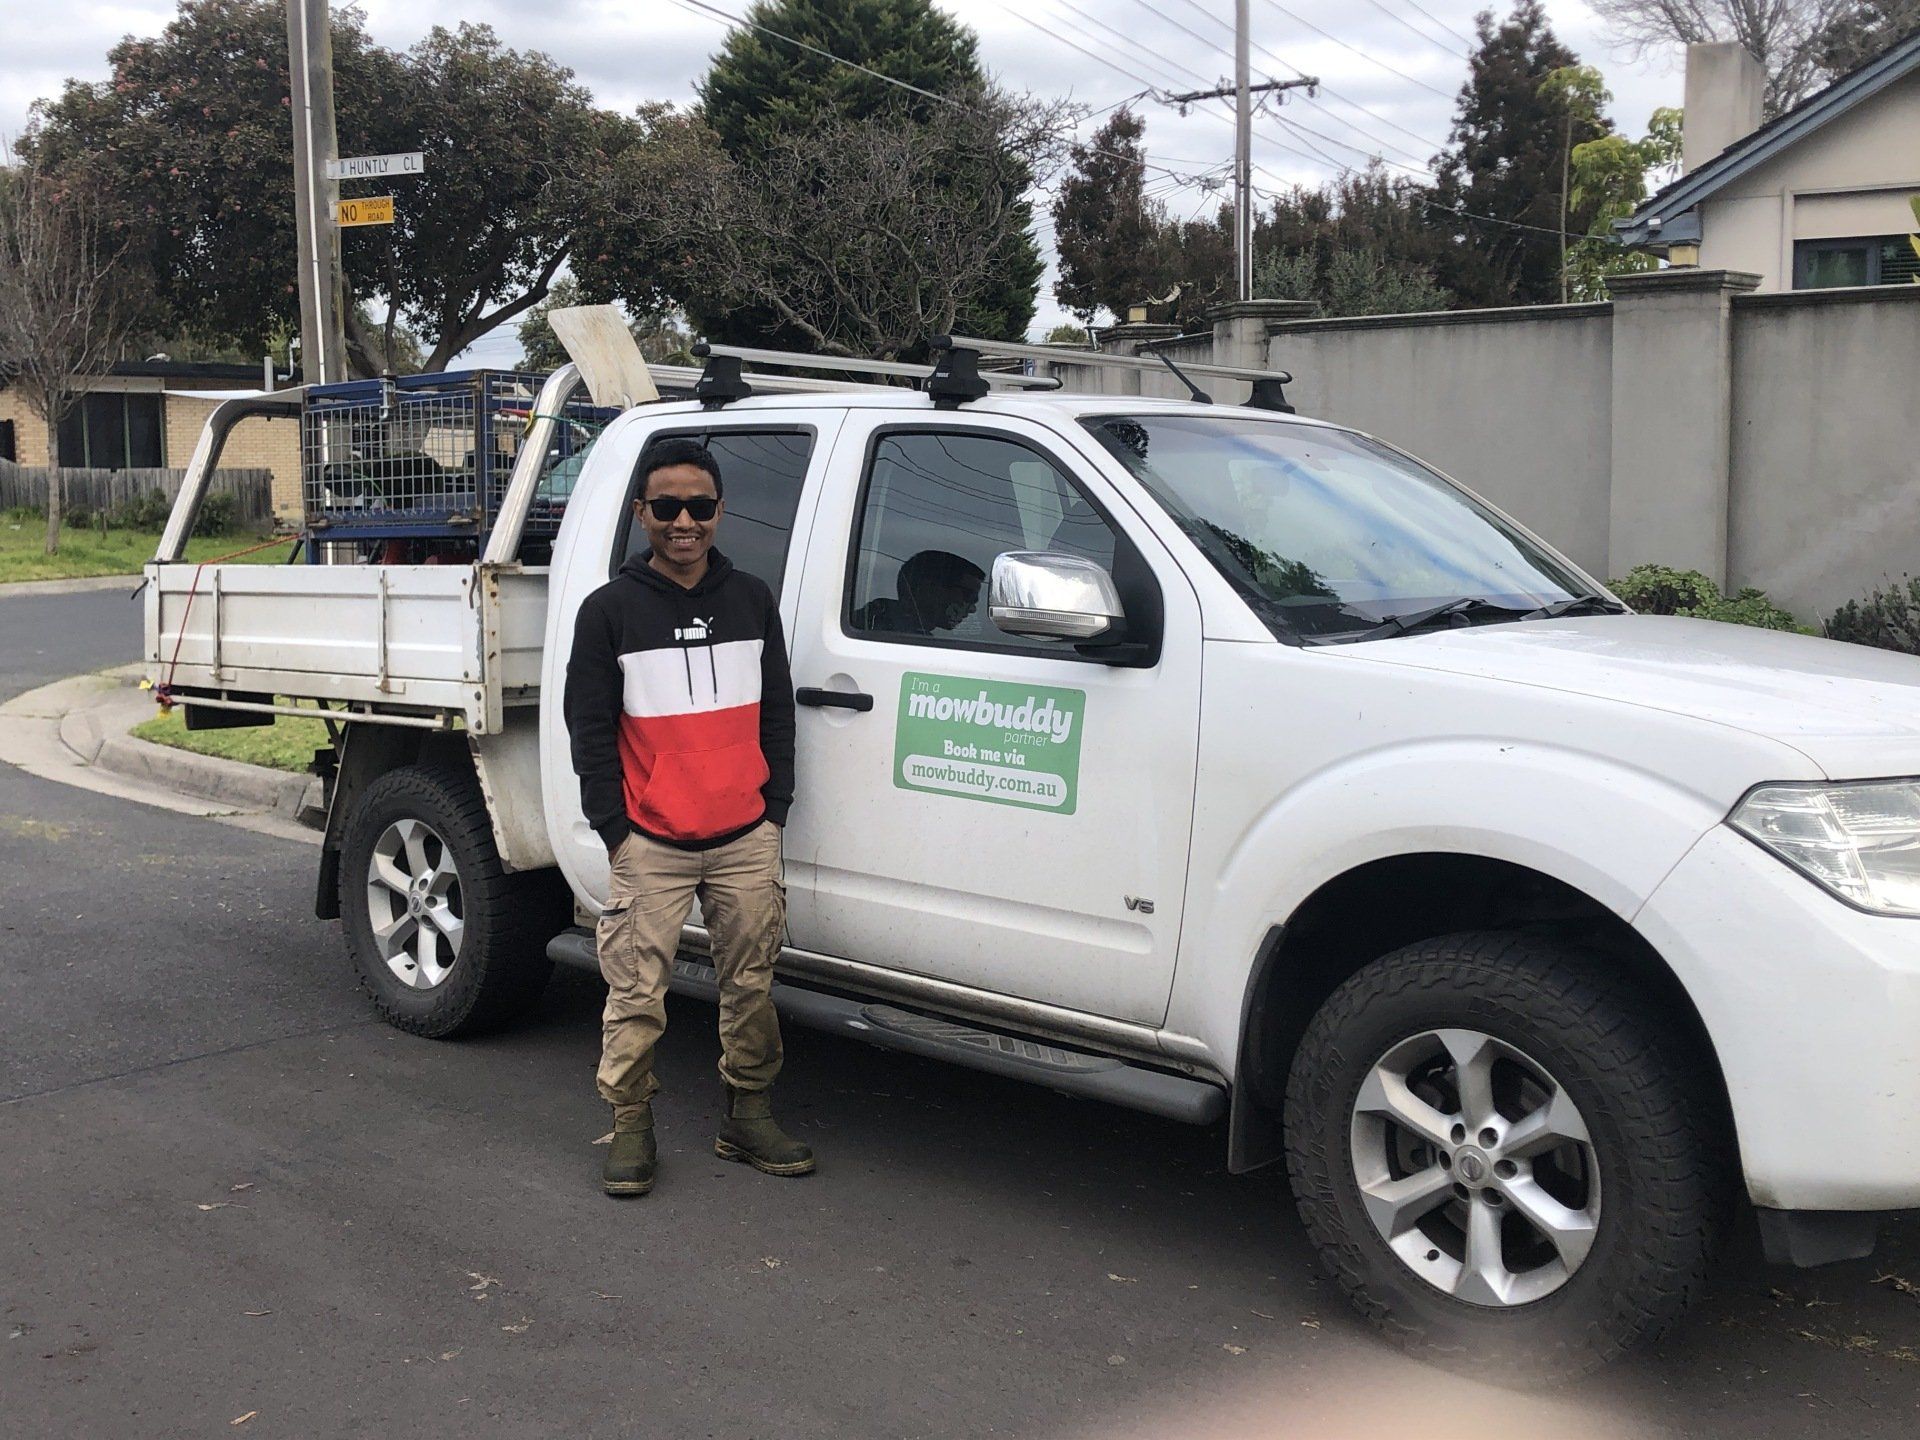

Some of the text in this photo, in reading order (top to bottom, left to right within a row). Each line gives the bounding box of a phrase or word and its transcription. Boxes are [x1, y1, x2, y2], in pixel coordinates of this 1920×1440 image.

[349, 156, 418, 175] HUNTLY CL
[341, 199, 390, 222] NO THROUGH
[367, 212, 385, 221] ROAD
[674, 627, 707, 640] PUMA
[932, 683, 941, 693] a
[908, 690, 1074, 744] mowbuddy
[1003, 731, 1048, 747] partner
[943, 739, 1026, 766] Book me via
[911, 765, 1057, 798] mowbuddy.com.au
